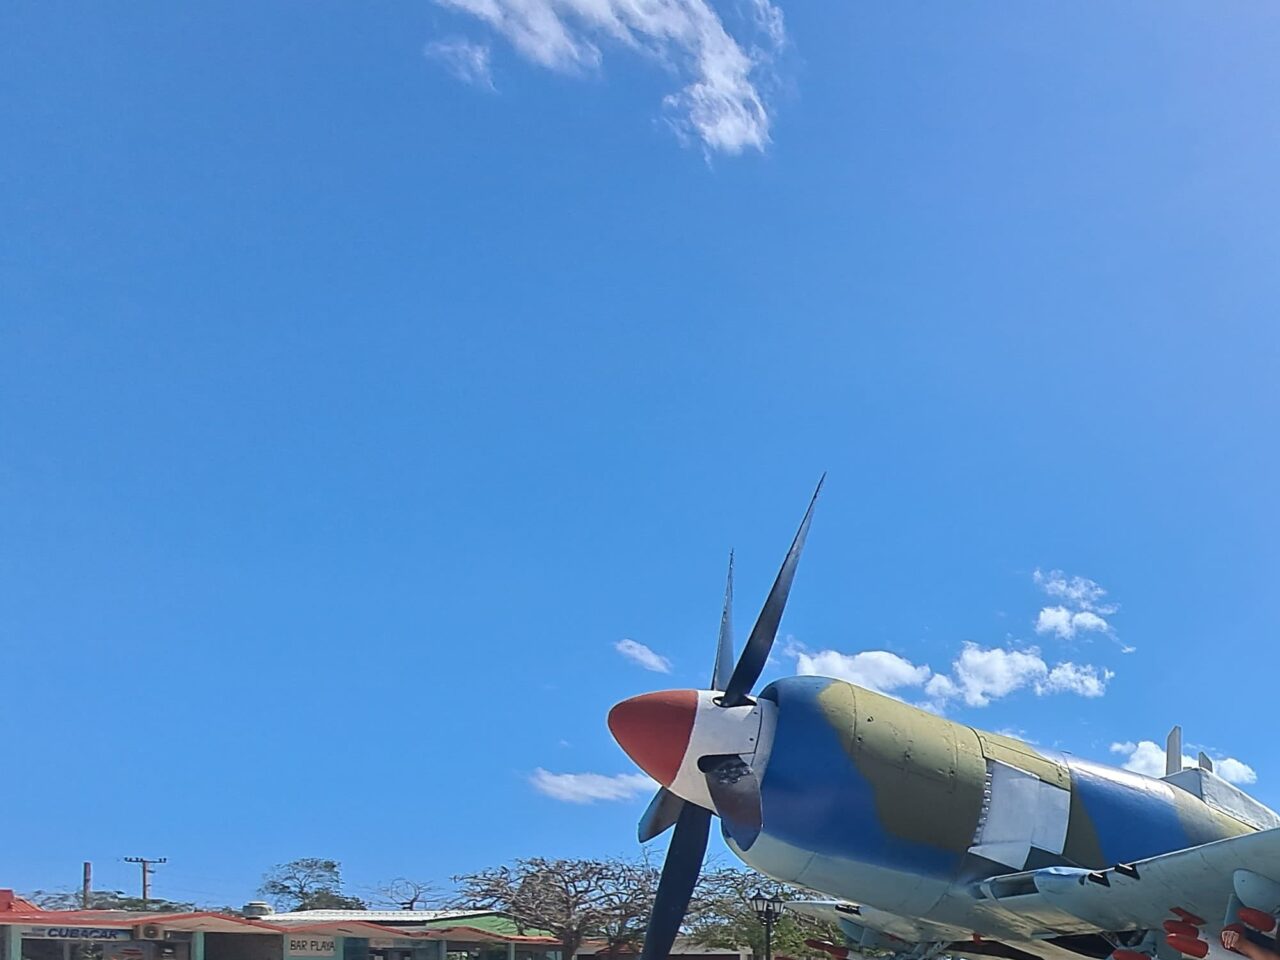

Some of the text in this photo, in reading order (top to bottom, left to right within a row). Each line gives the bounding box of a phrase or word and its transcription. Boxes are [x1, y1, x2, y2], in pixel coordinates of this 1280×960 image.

[47, 928, 118, 939] CUBACAR
[290, 940, 336, 951] BAR PLAYA
